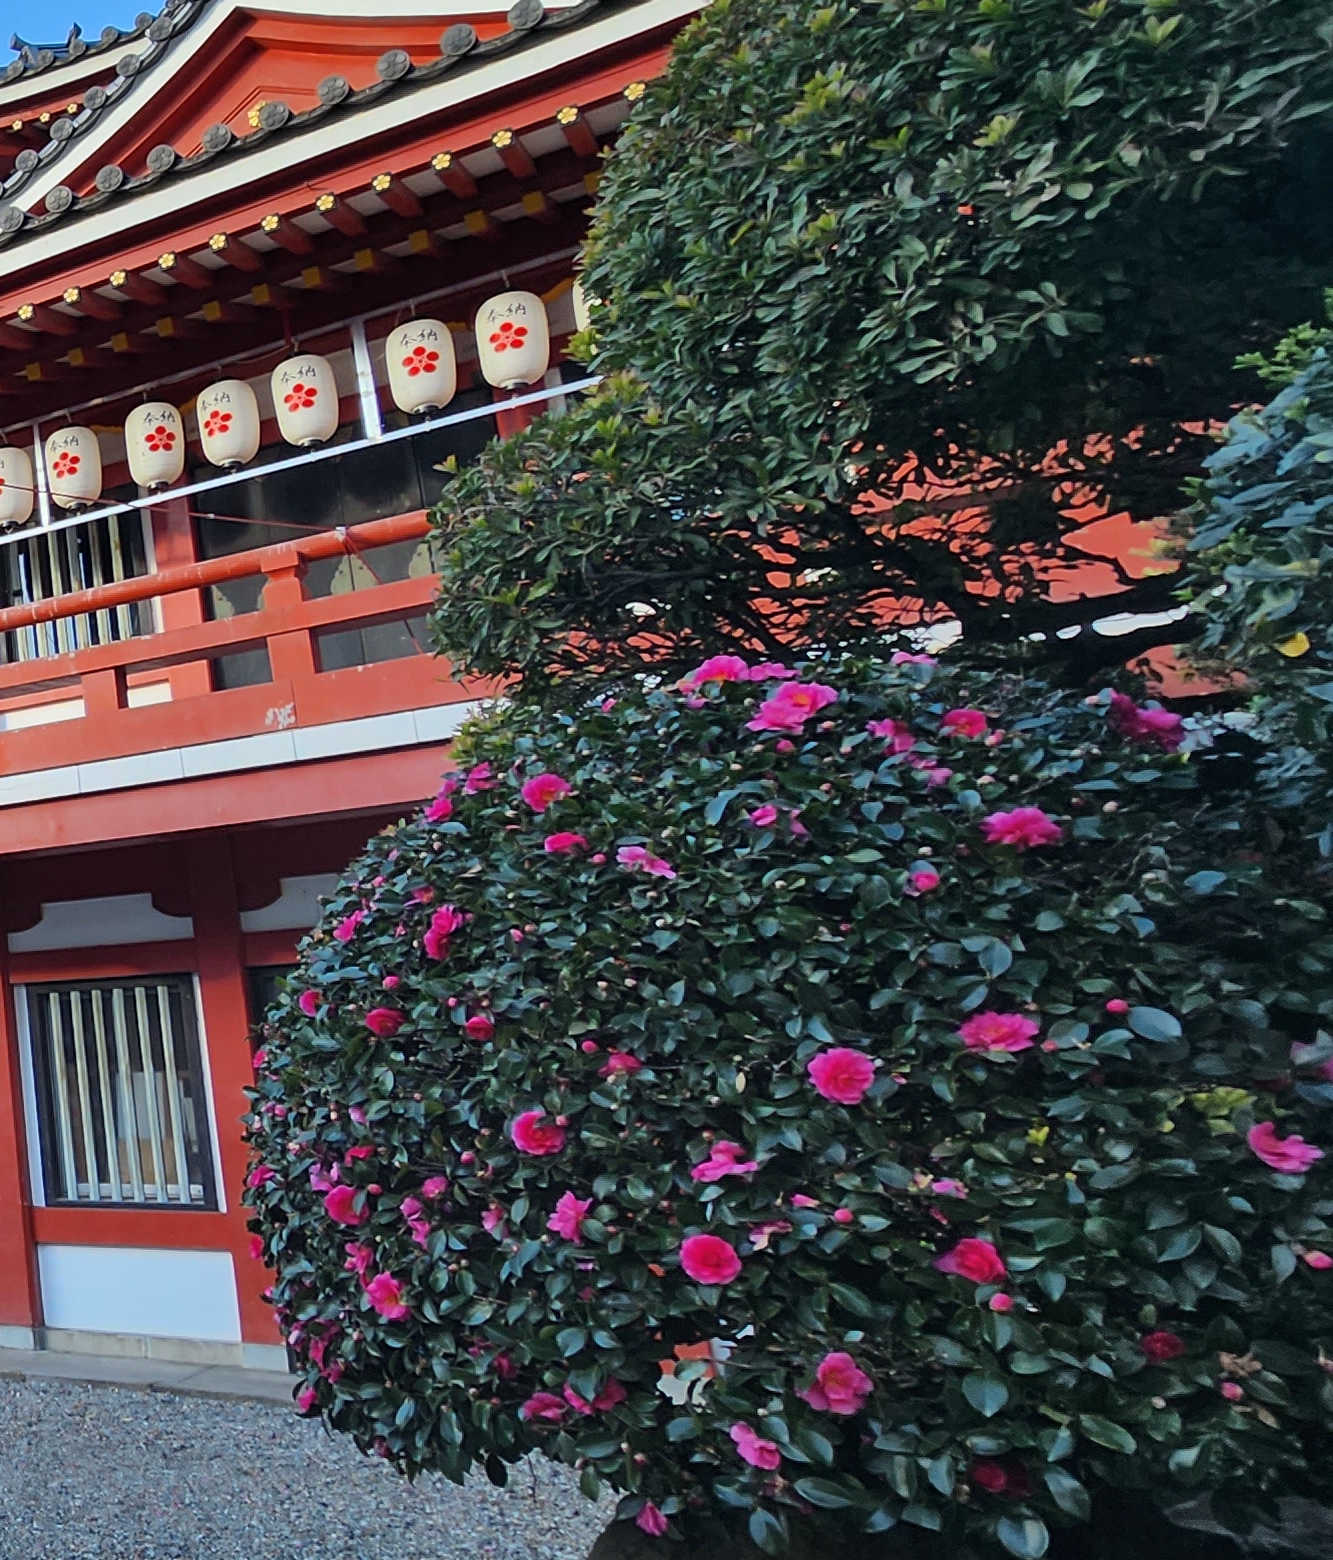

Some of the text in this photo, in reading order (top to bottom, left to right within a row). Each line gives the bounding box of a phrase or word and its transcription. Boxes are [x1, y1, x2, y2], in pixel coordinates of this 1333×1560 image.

[487, 302, 526, 325] 奉納
[398, 328, 438, 347] 奉納
[281, 365, 317, 385] 奉納
[143, 411, 176, 425] 奉納
[50, 436, 79, 452] 奉納
